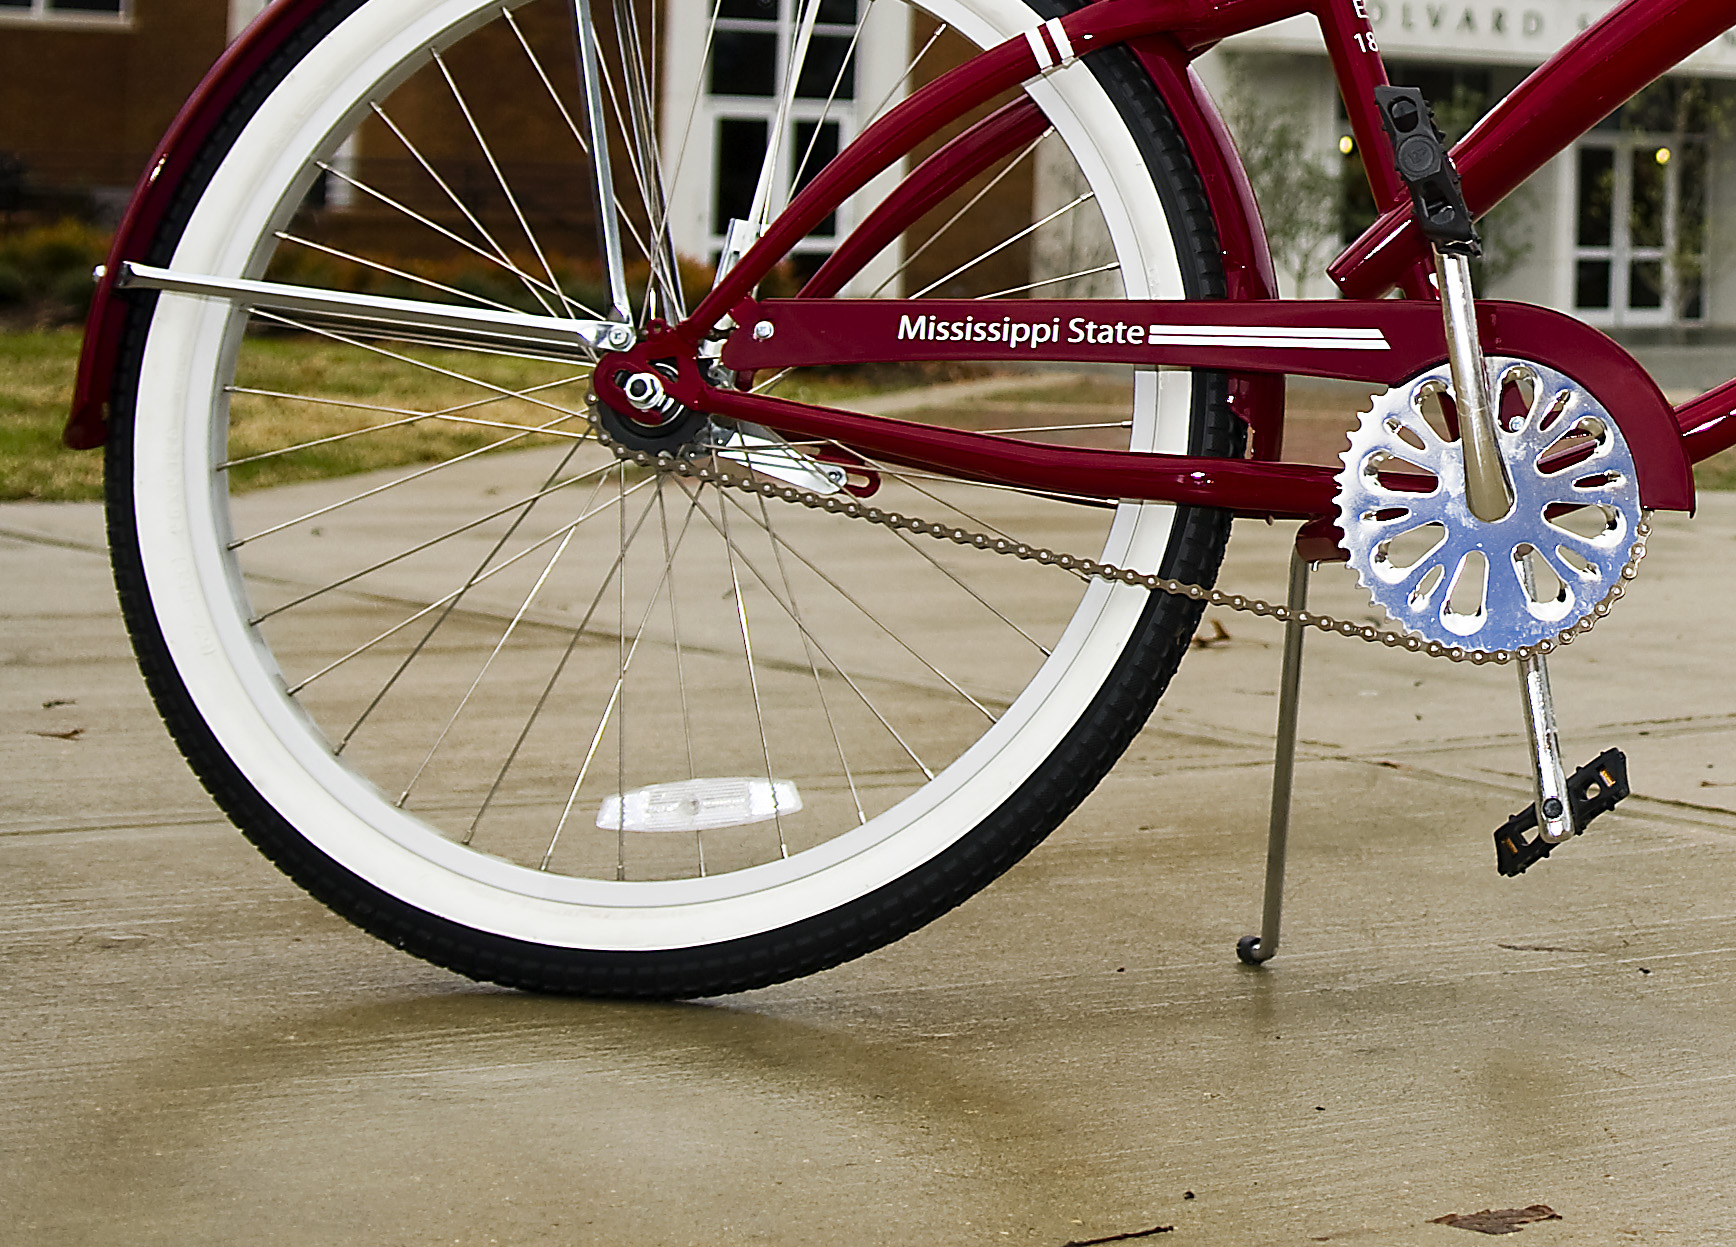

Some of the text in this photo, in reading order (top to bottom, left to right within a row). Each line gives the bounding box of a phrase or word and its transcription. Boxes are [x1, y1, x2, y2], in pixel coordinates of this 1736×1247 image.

[1353, 31, 1378, 53] 18
[897, 314, 1145, 349] Mississippi State
